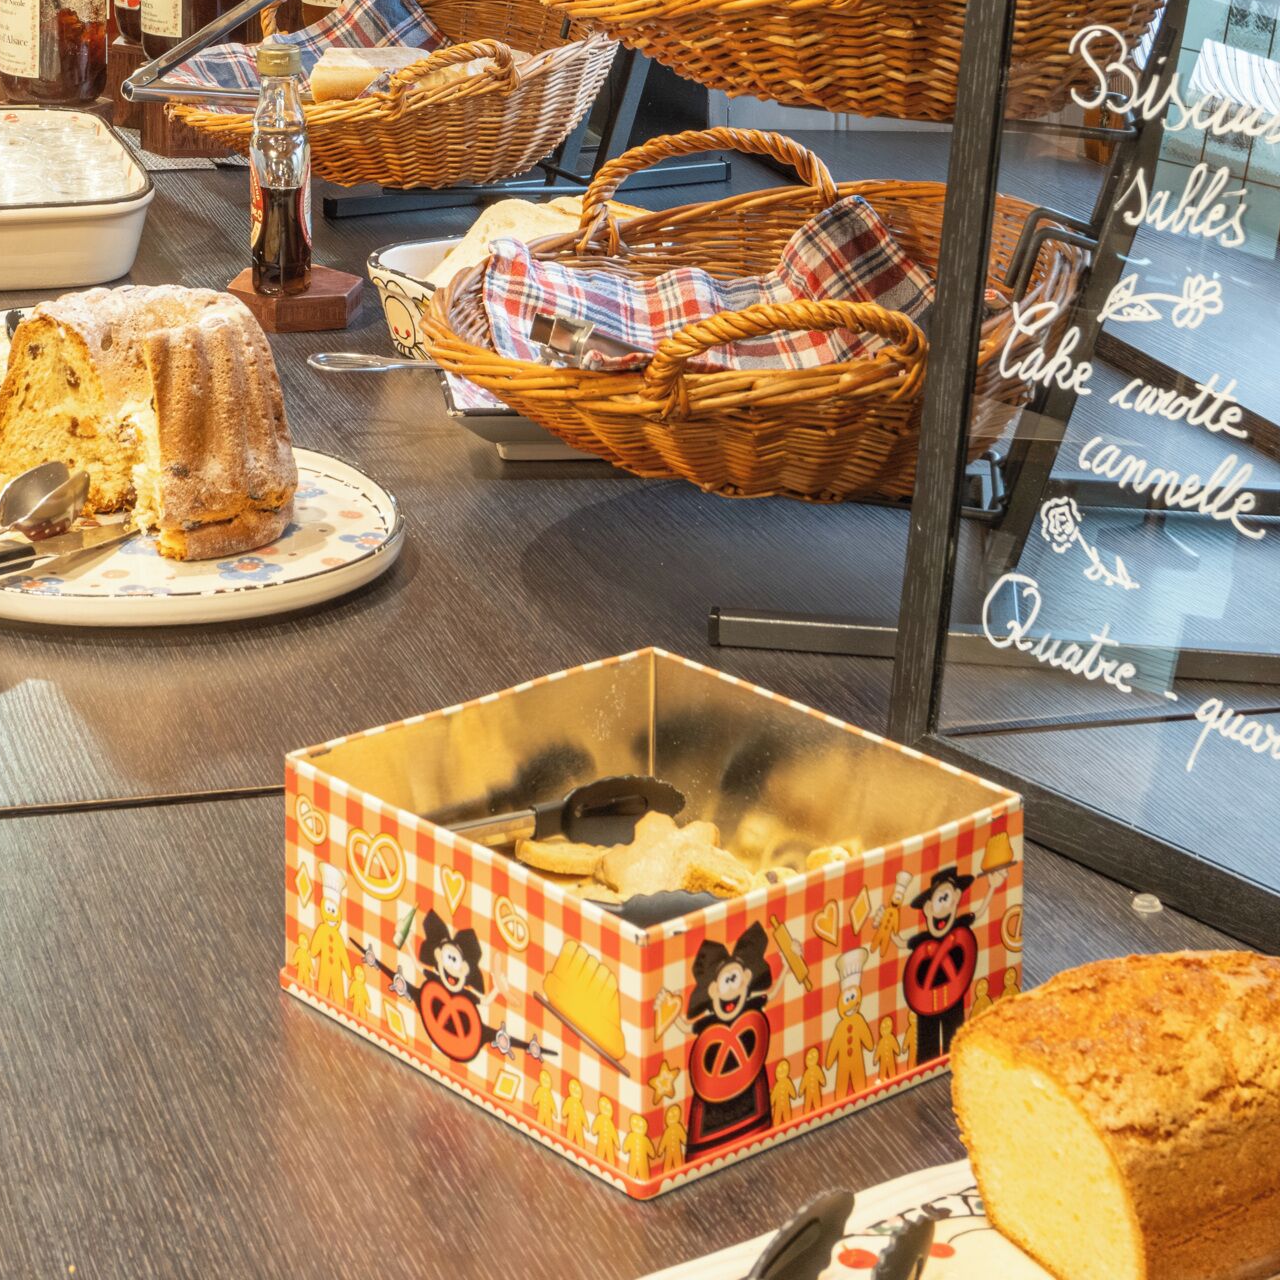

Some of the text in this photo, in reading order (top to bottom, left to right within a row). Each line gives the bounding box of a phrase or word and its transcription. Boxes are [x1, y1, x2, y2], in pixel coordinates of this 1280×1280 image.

[999, 300, 1094, 396] Cake
[1108, 373, 1248, 439] carotte
[1078, 436, 1266, 541] cannelle
[982, 572, 1138, 694] Quatre
